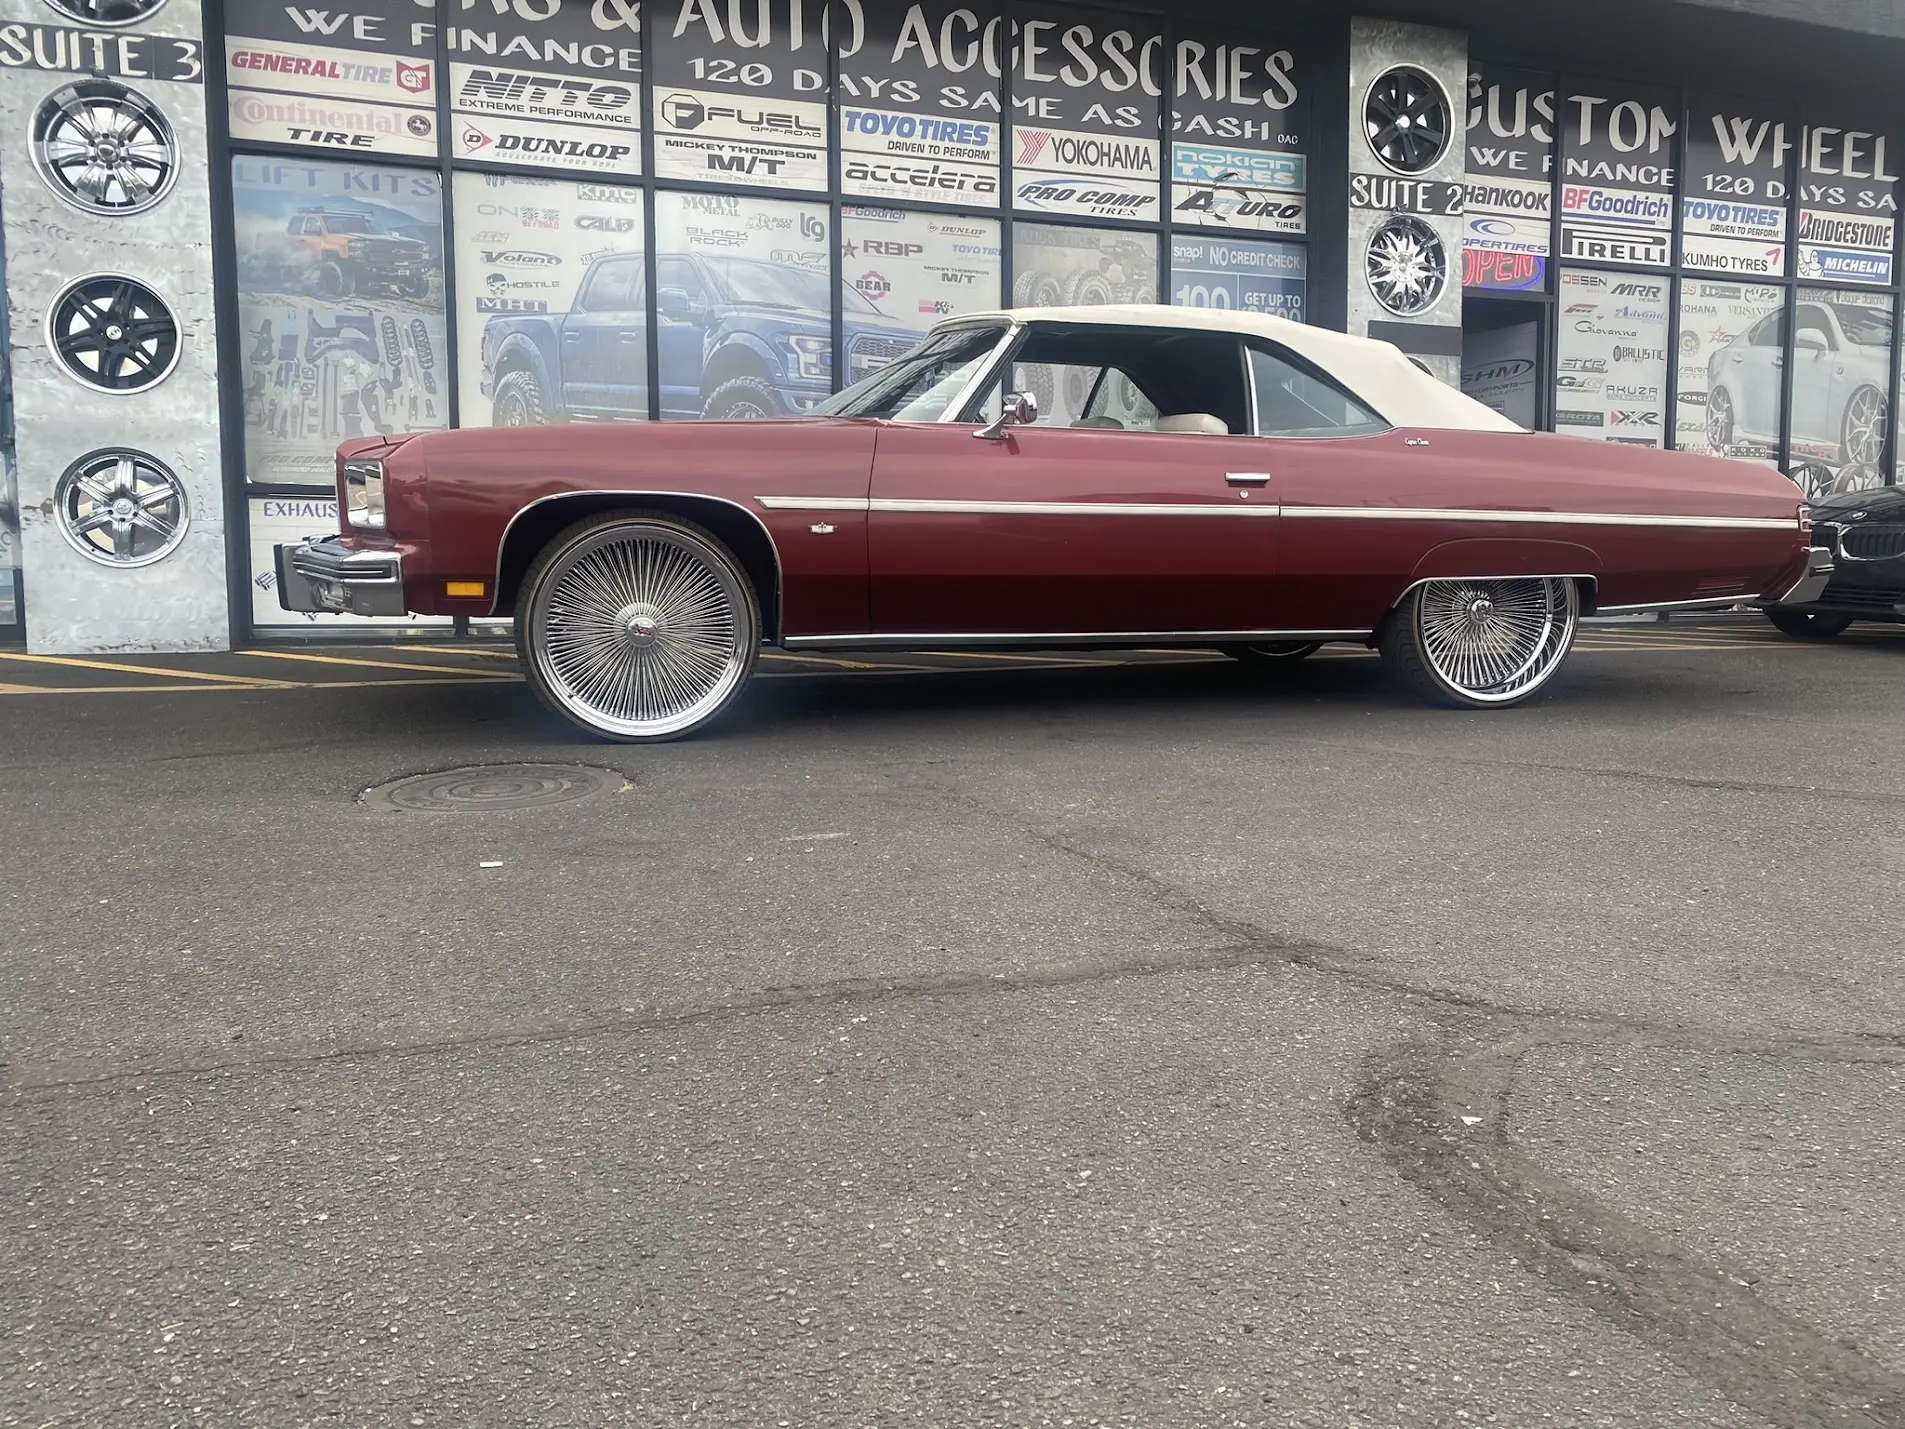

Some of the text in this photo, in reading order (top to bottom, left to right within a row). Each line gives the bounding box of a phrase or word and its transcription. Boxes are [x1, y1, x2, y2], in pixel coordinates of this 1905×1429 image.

[285, 6, 389, 41] WE
[411, 23, 641, 71] FINANCE
[0, 24, 202, 80] SUITE 3
[891, 3, 1298, 110] ACCESSORIES
[459, 69, 632, 110] NITTO
[687, 58, 773, 87] 120
[793, 69, 921, 103] DAYS
[940, 85, 1063, 120] SAME
[1082, 104, 1142, 128] AS
[1158, 110, 1269, 142] CASH
[233, 96, 402, 134] Continental
[459, 98, 632, 124] EXTREME PERFORMANCE
[708, 106, 821, 131] FUEL
[287, 127, 375, 148] TIRE
[750, 126, 822, 138] OFF-ROAD
[496, 133, 631, 160] DUNLOP
[665, 139, 817, 160] MICKEY THOMPSON
[887, 140, 990, 161] DRIVEN TO PERFORM
[1051, 136, 1154, 171] YOKOHAMA
[708, 153, 786, 175] M/T
[1470, 146, 1675, 187] WE FNANCE
[235, 163, 438, 197] LIFT KITS
[845, 160, 996, 194] accelera
[1702, 173, 1755, 196] 120
[1017, 184, 1156, 208] PRO COMP
[1351, 174, 1464, 215] SUITE 2
[1562, 187, 1669, 218] BFGoodrich
[1089, 205, 1138, 217] TIRES
[686, 226, 749, 238] BLACK
[940, 225, 987, 236] DUNLOP
[1274, 221, 1300, 230] TIRES
[1710, 223, 1779, 238] DRIVEN TO PERFORM
[1799, 212, 1891, 247] BRIDGESTONE
[690, 237, 741, 247] ROCK
[863, 239, 924, 257] RBP
[1562, 228, 1667, 263] PIRELLI
[1173, 246, 1300, 269] snap! NO CREDIT CHECK
[1682, 252, 1768, 271] KUMHO TYRES
[1824, 257, 1888, 275] MICHELIN
[508, 280, 560, 289] HOSTILE
[855, 279, 891, 291] GEAR
[941, 272, 976, 284] M/T
[1560, 273, 1607, 287] OSSEN
[1244, 291, 1301, 308] GET UP TO
[1610, 283, 1662, 298] MRR
[480, 298, 546, 311] MHT
[1575, 320, 1637, 337] Giovanna
[1622, 346, 1665, 361] BALLISTIC
